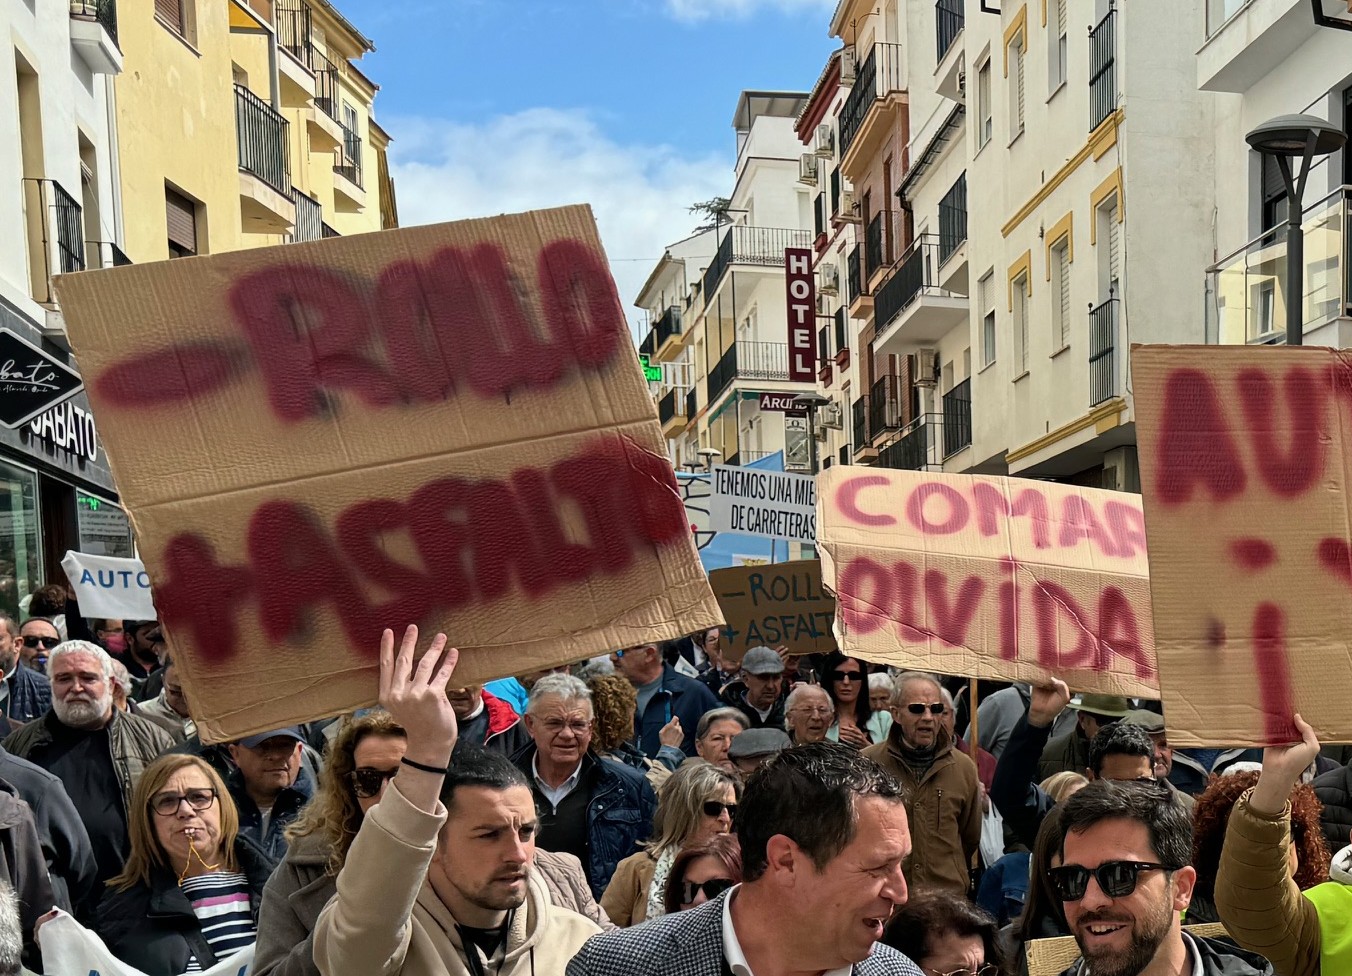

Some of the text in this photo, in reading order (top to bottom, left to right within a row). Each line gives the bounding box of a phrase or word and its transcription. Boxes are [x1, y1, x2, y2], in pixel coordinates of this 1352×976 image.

[789, 254, 811, 374] HOTEL
[715, 468, 766, 500] TENEMOS
[768, 475, 792, 504] UNA
[731, 504, 816, 541] DE CARRETERAS
[80, 568, 151, 588] AUTO
